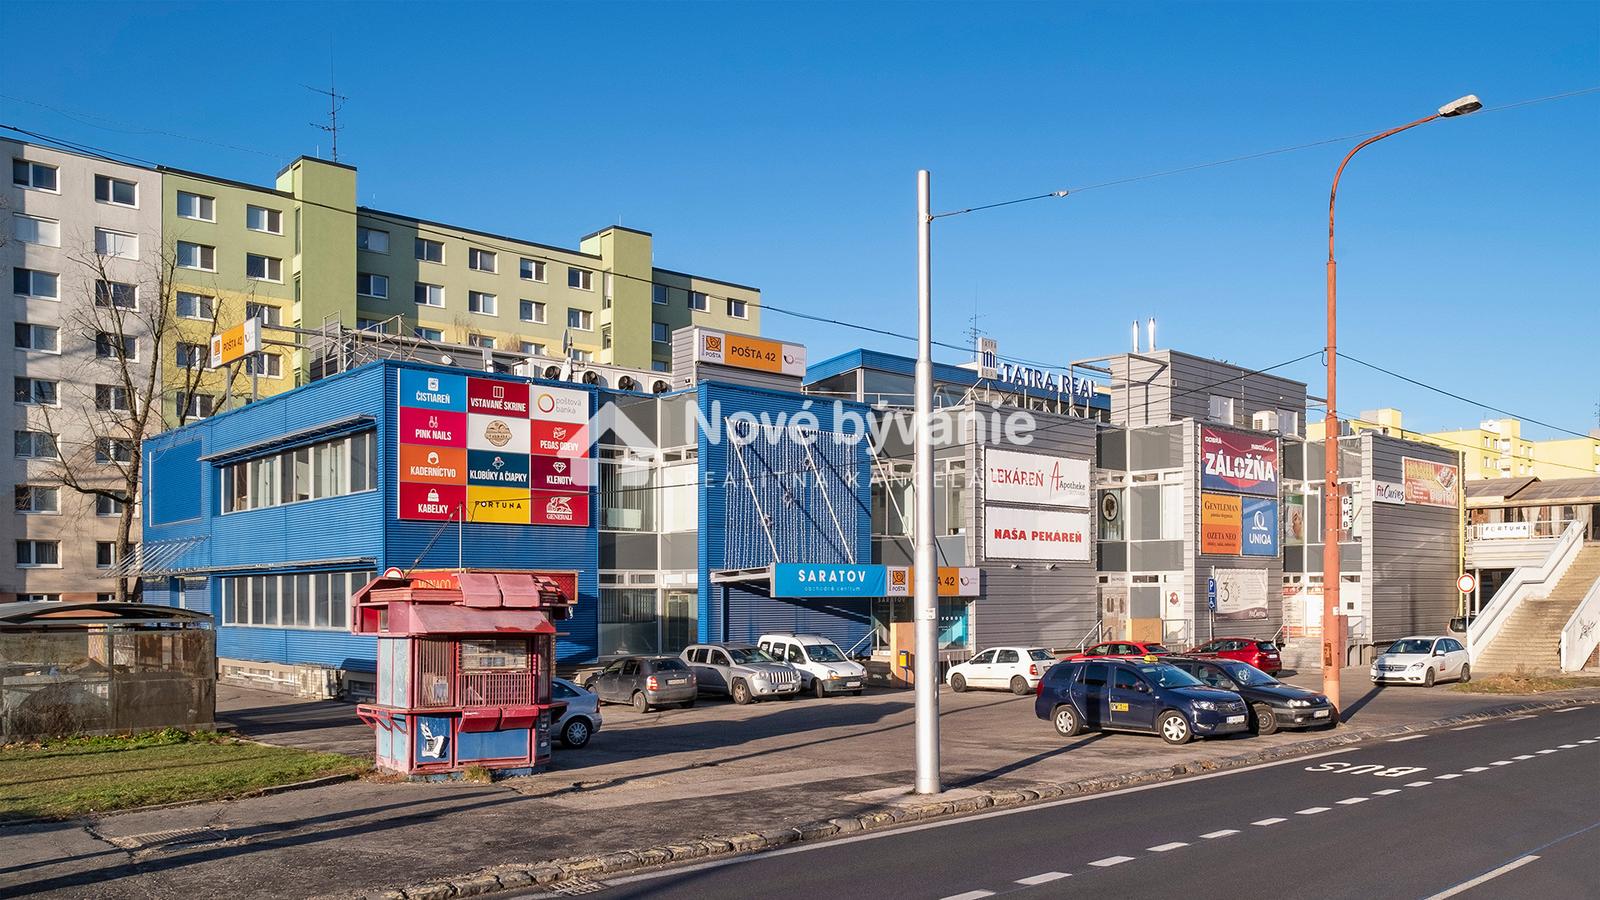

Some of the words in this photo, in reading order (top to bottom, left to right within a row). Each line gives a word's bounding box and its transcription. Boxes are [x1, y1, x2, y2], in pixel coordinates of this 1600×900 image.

[705, 351, 722, 359] POŠTA
[731, 345, 763, 360] POŠTA
[765, 352, 776, 362] 42
[1001, 363, 1054, 392] TATRA
[1058, 374, 1098, 398] REAL
[416, 391, 450, 404] ČISTIAREŇ
[556, 397, 582, 407] poštová
[470, 397, 504, 410] VSTAVANÉ
[504, 402, 526, 412] SKRINE
[415, 429, 431, 440] PINK
[432, 430, 452, 441] NAILS
[540, 441, 559, 450] PEGAS
[410, 465, 456, 478] KADERNÍCTVO
[1205, 449, 1275, 482] ZÁLOŽŇA
[469, 469, 499, 481] KLOBÚKY
[499, 472, 504, 481] A
[504, 471, 528, 482] ČIAPKY
[546, 475, 573, 485] KLENOTY
[991, 467, 1044, 487] LEKÁREŇ
[1059, 481, 1086, 491] Apotheke
[418, 503, 449, 514] KABELKY
[475, 500, 522, 509] FORTUNA
[1204, 501, 1239, 512] GENTLEMAN
[546, 513, 573, 521] GENERALI
[994, 527, 1027, 541] NAŠA
[1032, 530, 1082, 543] PEKÁREŇ
[1249, 533, 1272, 545] UNIQA
[798, 570, 866, 583] SARATOV
[944, 576, 955, 586] 42
[1304, 762, 1428, 778] BUS
